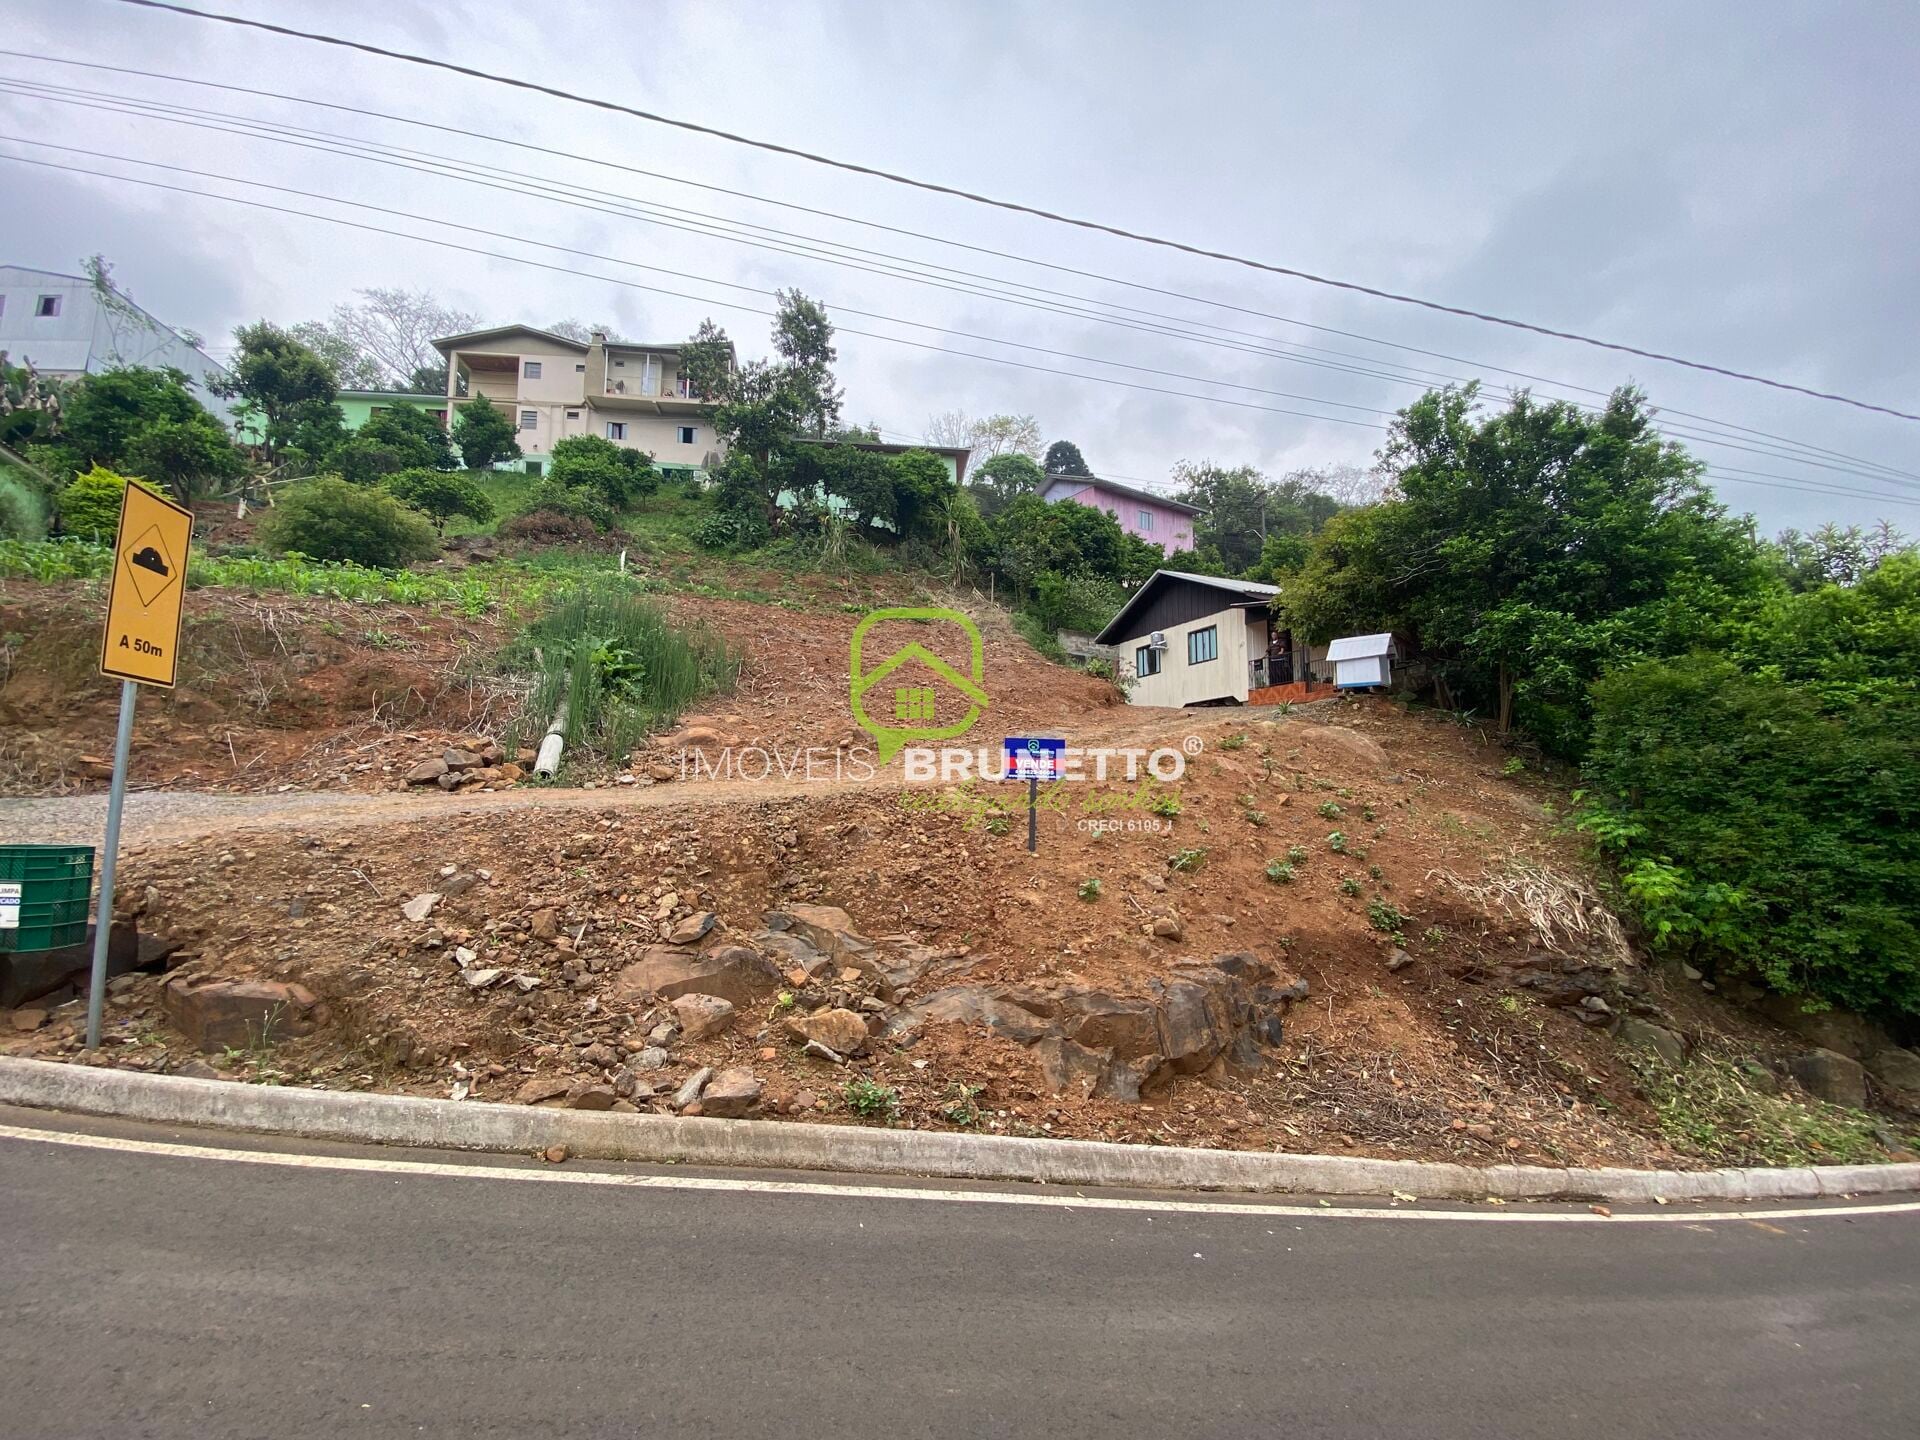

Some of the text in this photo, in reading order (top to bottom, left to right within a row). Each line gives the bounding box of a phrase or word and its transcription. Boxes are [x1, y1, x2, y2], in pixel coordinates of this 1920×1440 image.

[119, 634, 163, 657] A 50m
[1015, 759, 1054, 769] VENDE
